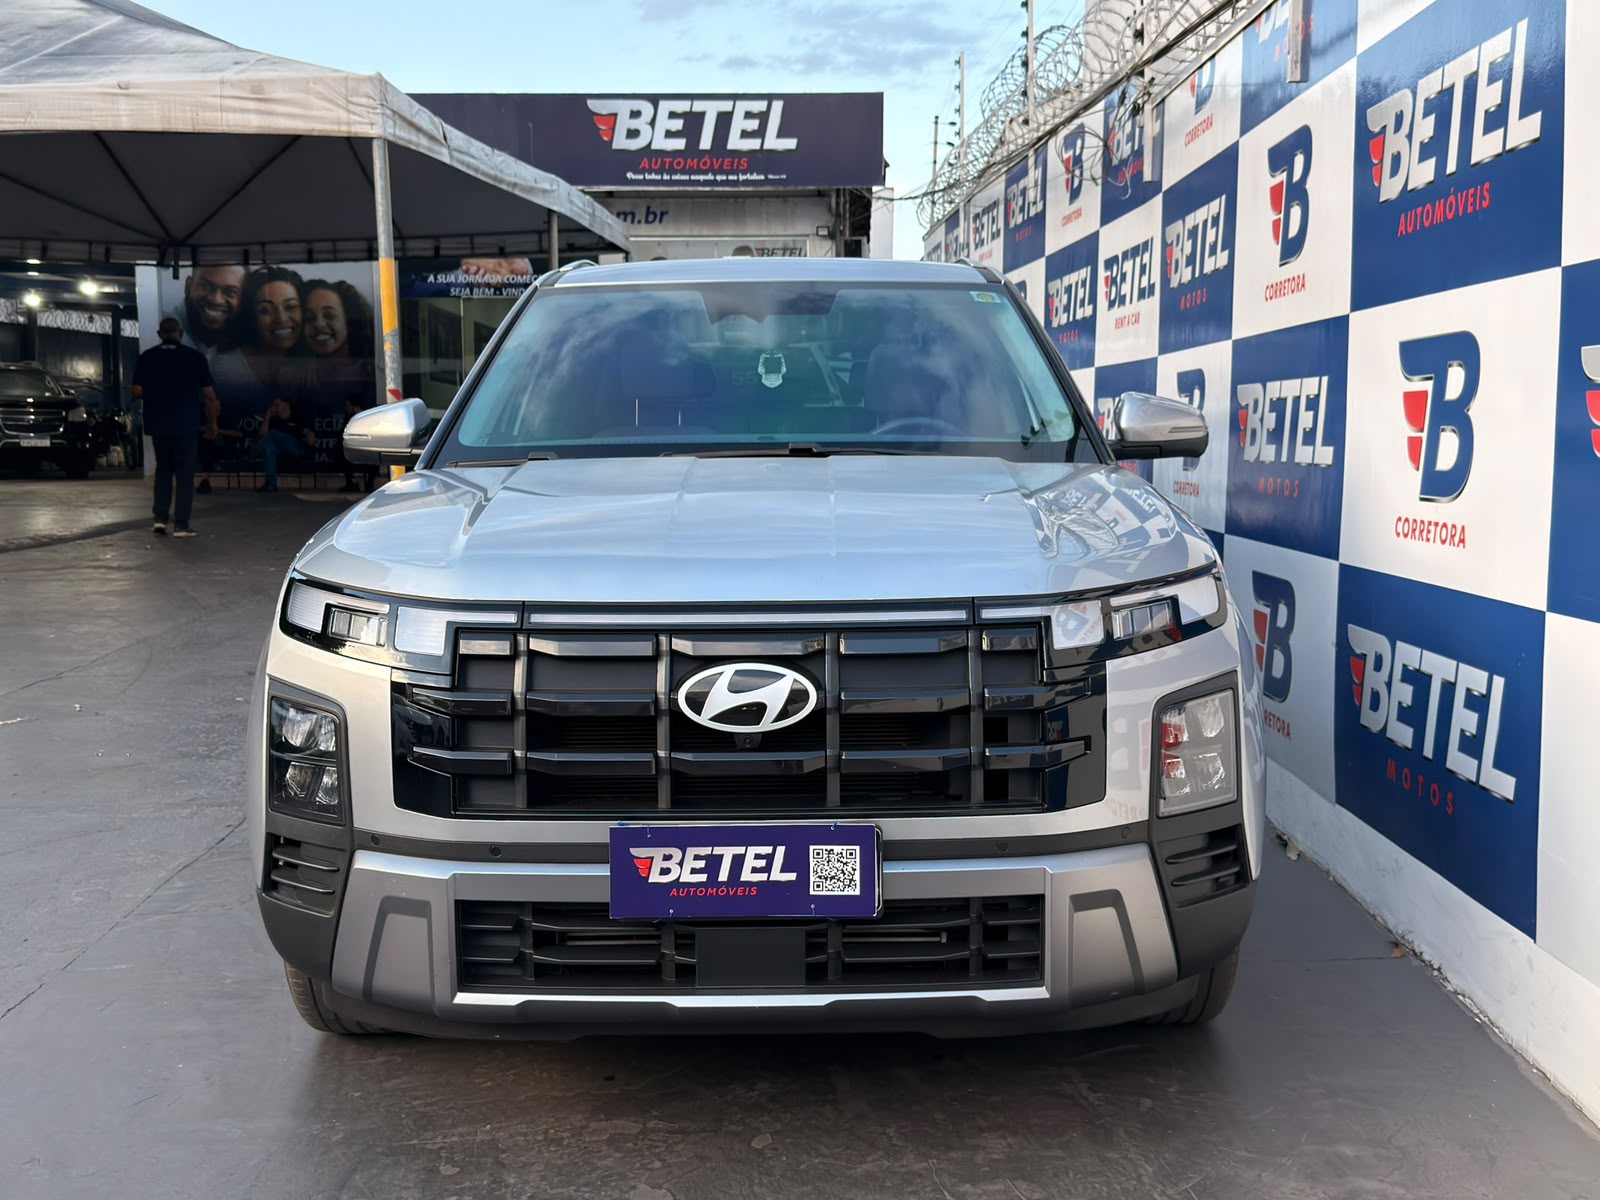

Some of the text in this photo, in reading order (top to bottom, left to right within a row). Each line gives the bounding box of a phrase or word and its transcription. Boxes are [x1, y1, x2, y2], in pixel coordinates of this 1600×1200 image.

[586, 99, 798, 151] BETEL
[1366, 17, 1542, 204] BETEL
[639, 156, 749, 170] AUTOMÓVEIS
[1267, 124, 1313, 268] B
[1397, 182, 1491, 237] AUTOMÓVEIS
[1165, 194, 1230, 289] BETEL
[436, 274, 456, 283] SUA
[458, 274, 501, 284] JORNADA
[450, 287, 470, 296] SEJA
[472, 287, 494, 296] BEM
[1048, 265, 1094, 329] BETEL
[1103, 236, 1156, 312] BETEL
[1264, 273, 1306, 303] CORRETORA
[1236, 375, 1335, 467] BETEL
[1400, 330, 1481, 504] B
[1258, 476, 1299, 499] MOTOS
[1394, 515, 1467, 549] CORRETORA
[1252, 569, 1297, 703] B
[1348, 623, 1517, 804] BETEL
[1386, 757, 1455, 816] MOTOS
[629, 845, 798, 884] BETEL
[669, 885, 758, 898] AUTOMÓVEIS
